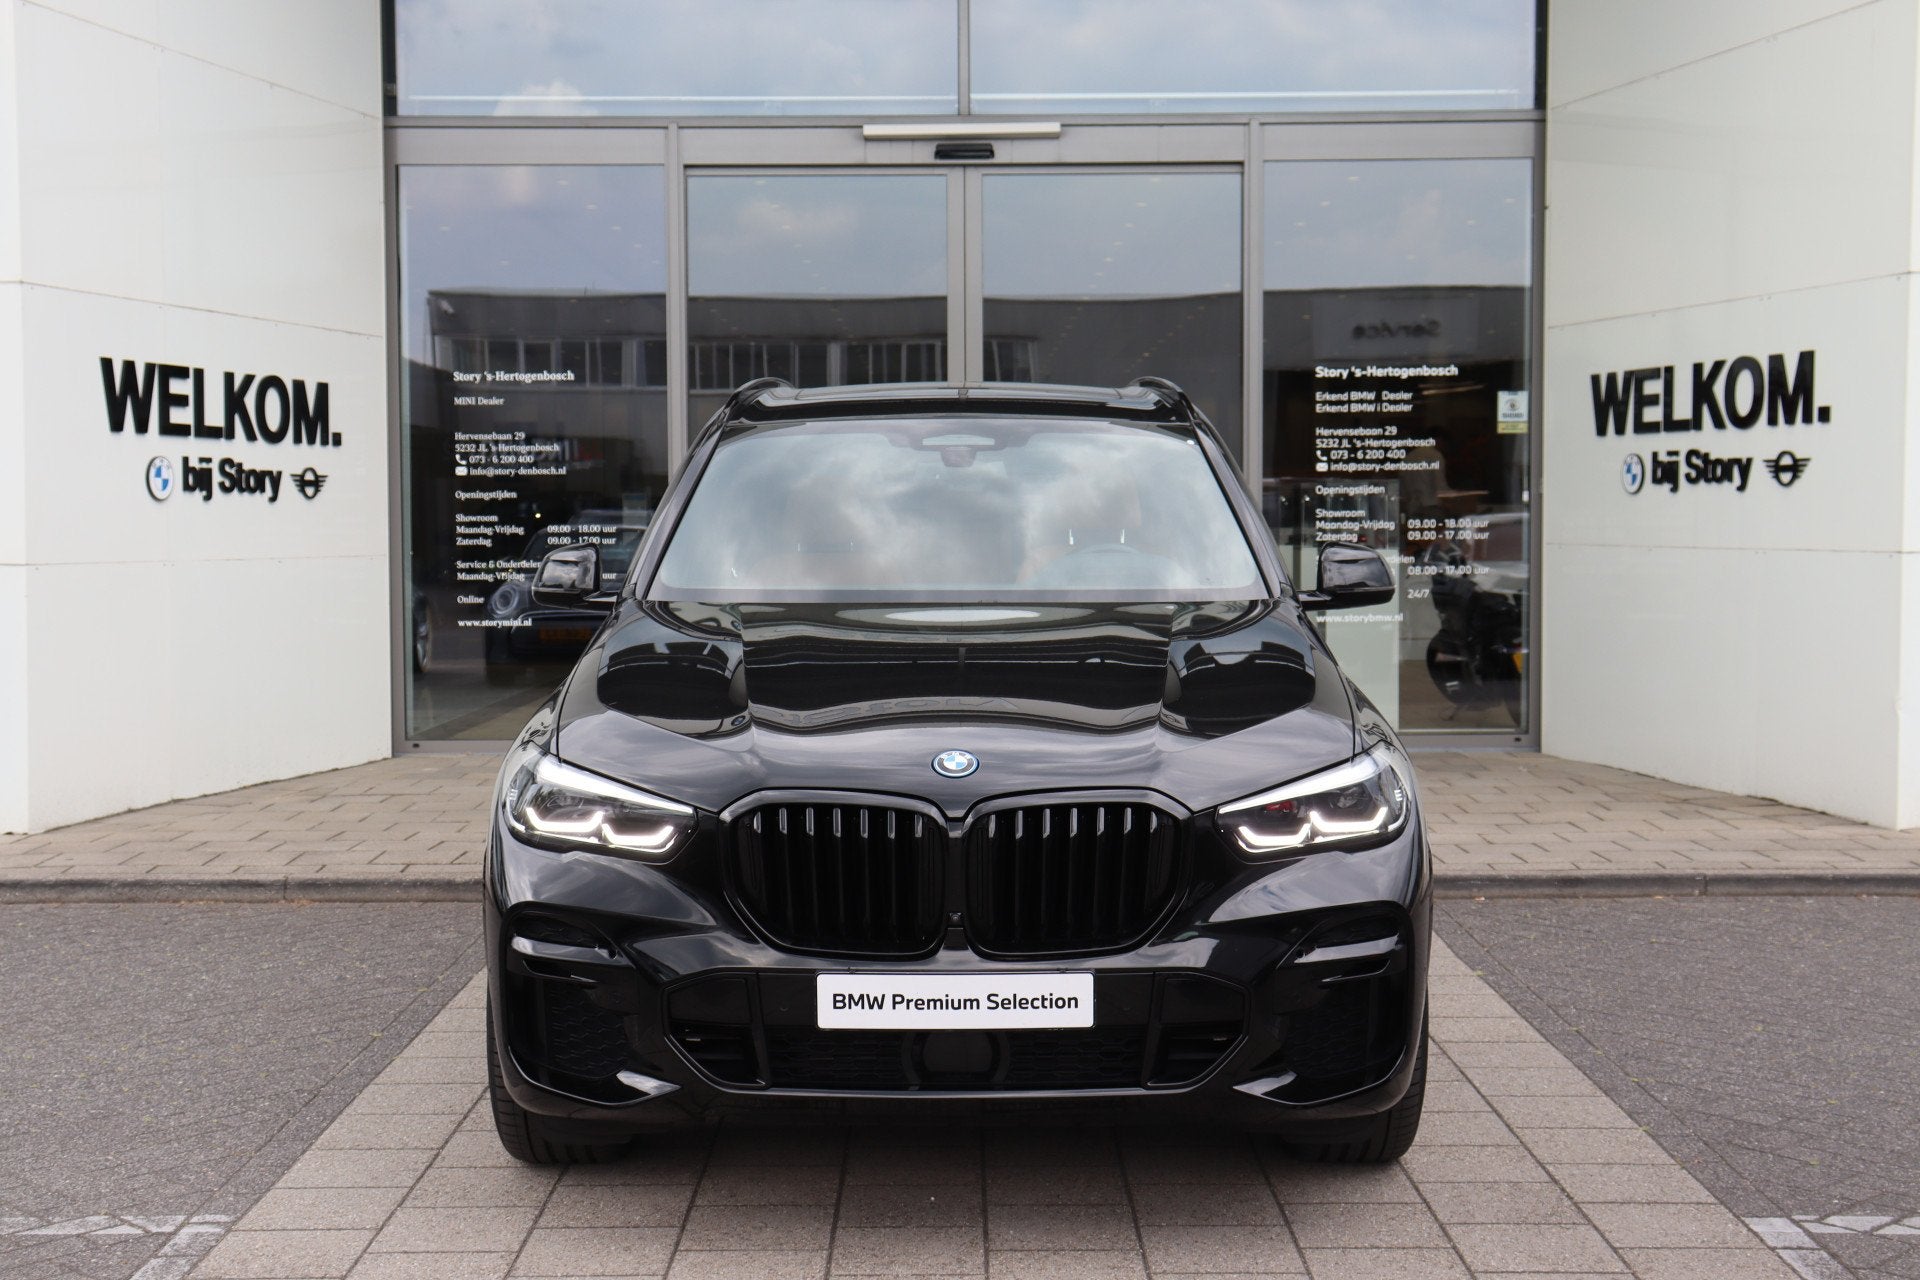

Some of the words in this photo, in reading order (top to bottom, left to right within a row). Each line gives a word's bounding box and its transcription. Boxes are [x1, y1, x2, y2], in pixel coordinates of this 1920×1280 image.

[453, 371, 481, 384] Story
[1315, 366, 1348, 380] Story
[1315, 391, 1348, 401] Erkend
[1350, 391, 1376, 401] BMW
[1382, 391, 1413, 400] Dealer
[1591, 350, 1831, 436] WELKOM.
[99, 356, 342, 446] WELKOM.
[454, 396, 475, 405] MINI
[478, 396, 504, 405] Dealer
[1315, 403, 1348, 413] Erkend
[1350, 403, 1375, 413] BMW
[1382, 403, 1413, 412] Dealer
[455, 431, 512, 440] Hervensebaan
[514, 431, 526, 440] 29
[1315, 426, 1383, 436] Hervensebaan
[1384, 425, 1397, 435] 29
[455, 443, 476, 453] 5232
[1315, 438, 1339, 448] 5232
[1341, 438, 1351, 448] JL
[469, 455, 485, 463] 073
[500, 455, 516, 463] 200
[518, 455, 534, 463] 400
[1330, 449, 1349, 459] 073
[1366, 449, 1385, 459] 200
[1386, 449, 1406, 459] 400
[470, 466, 567, 477] info@story-denbosch.nl
[1330, 460, 1440, 472] info@story-denbosch.nl
[1652, 450, 1680, 493] bij
[1685, 448, 1753, 492] Story
[182, 456, 213, 502] bij
[218, 457, 282, 503] Story
[455, 489, 517, 500] Openingstijden
[1315, 484, 1386, 496] Openingstijden
[455, 513, 498, 522] Showroom
[1315, 508, 1366, 518] Showroom
[456, 525, 525, 536] Maandag-Vrijdag
[547, 524, 571, 533] 09.00
[578, 524, 601, 533] 18.00
[1316, 520, 1395, 531] Maandag-Vrijdag
[1407, 518, 1436, 529] 09.00
[1445, 518, 1472, 528] 18.00
[1473, 520, 1489, 528] uur
[456, 537, 492, 547] Zaterdag
[547, 536, 571, 545] 09.00
[601, 537, 617, 545] uur
[1315, 532, 1359, 543] Zaterdag
[1407, 530, 1436, 540] 09.00
[456, 560, 487, 569] Service
[488, 560, 495, 569] &
[1407, 566, 1437, 575] 08.00
[457, 572, 525, 582] Maandag-Vrijdag
[602, 572, 617, 580] uur
[457, 595, 485, 604] Online
[1407, 589, 1430, 599] 24/7
[458, 617, 532, 628] www.storymini.nl
[1316, 613, 1403, 624] www.storybmw.nl
[832, 993, 886, 1010] BMW
[892, 993, 980, 1010] Premium
[986, 993, 1079, 1010] Selection
